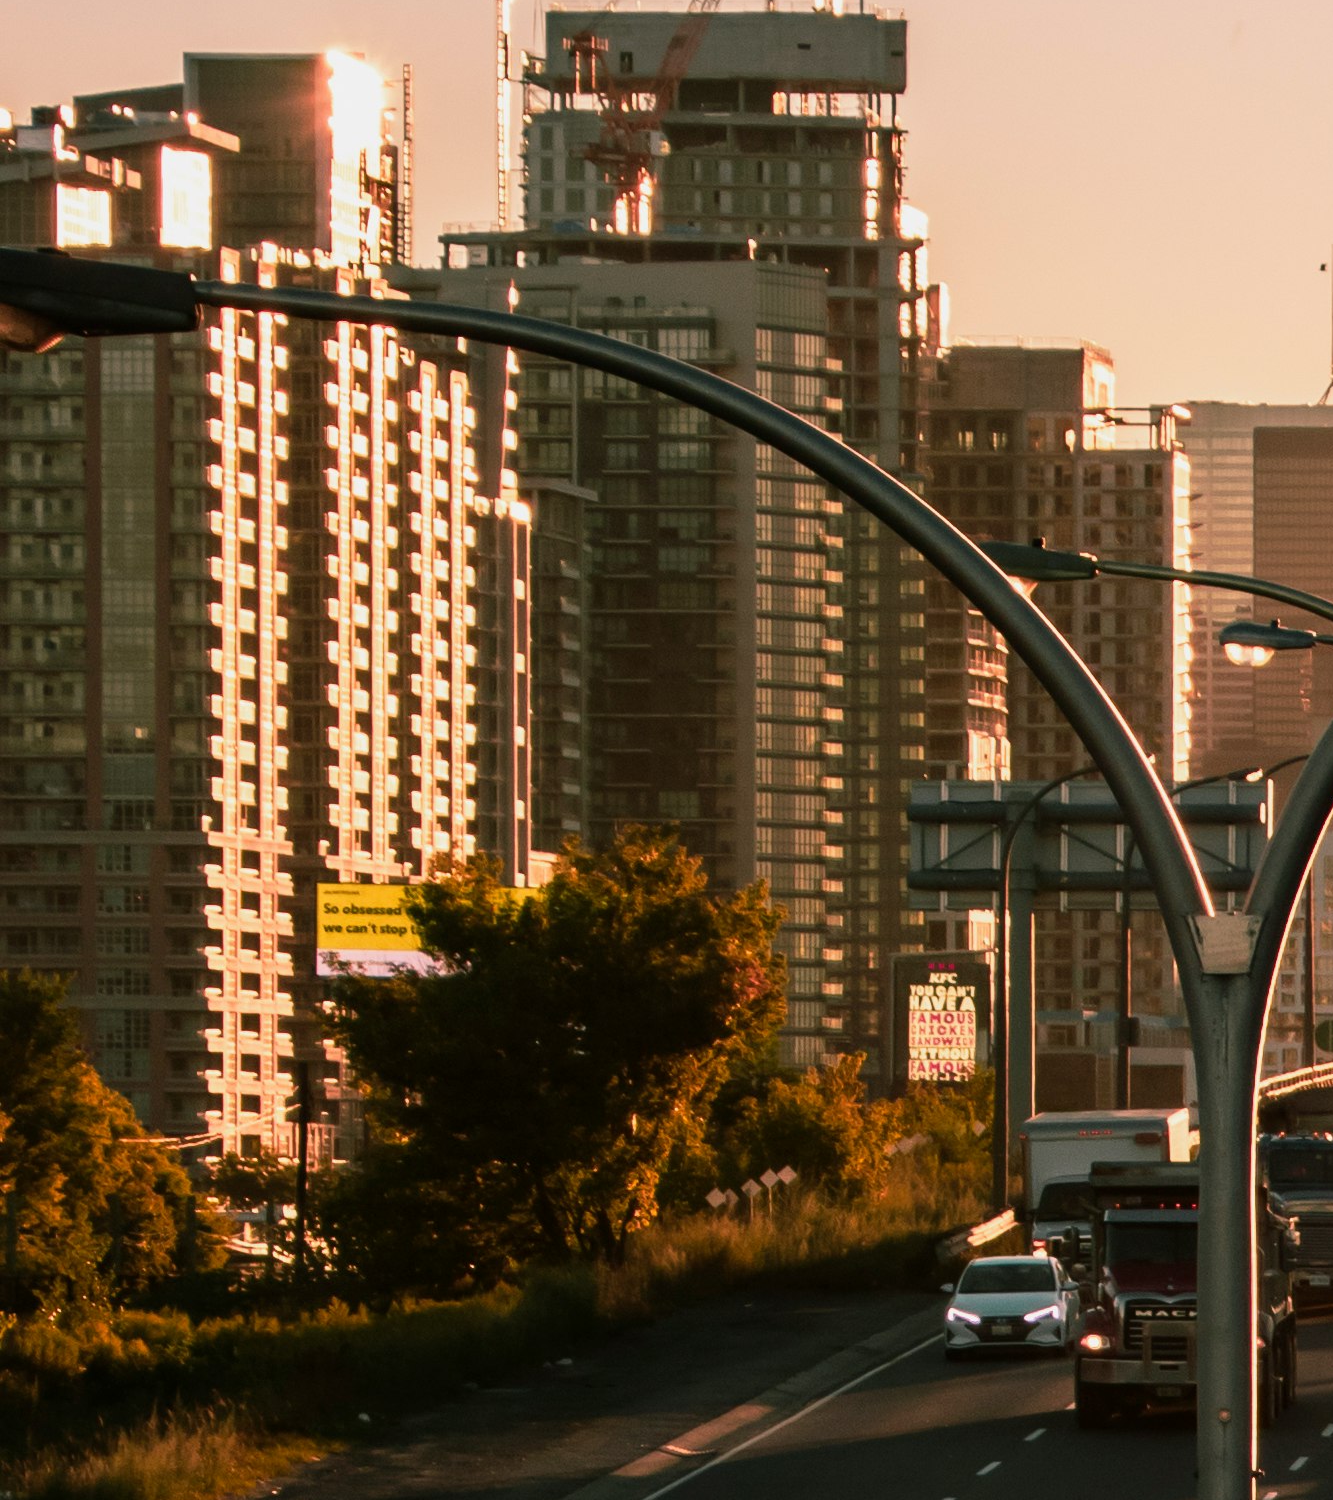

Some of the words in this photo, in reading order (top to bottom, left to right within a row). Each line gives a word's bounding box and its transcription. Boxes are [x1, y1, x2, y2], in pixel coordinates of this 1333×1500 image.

[323, 902, 339, 914] So
[323, 924, 343, 933] we
[345, 921, 377, 934] can't
[380, 923, 408, 937] stop
[928, 972, 958, 984] KFC
[909, 984, 935, 997] YOU
[935, 985, 976, 998] CAN'T
[909, 995, 957, 1011] HAVE
[959, 996, 976, 1011] A
[910, 1012, 975, 1024] FAMOUS
[910, 1025, 975, 1036] CHICKEN
[910, 1037, 975, 1046] SANDWICH
[909, 1047, 976, 1060] WITHOUT
